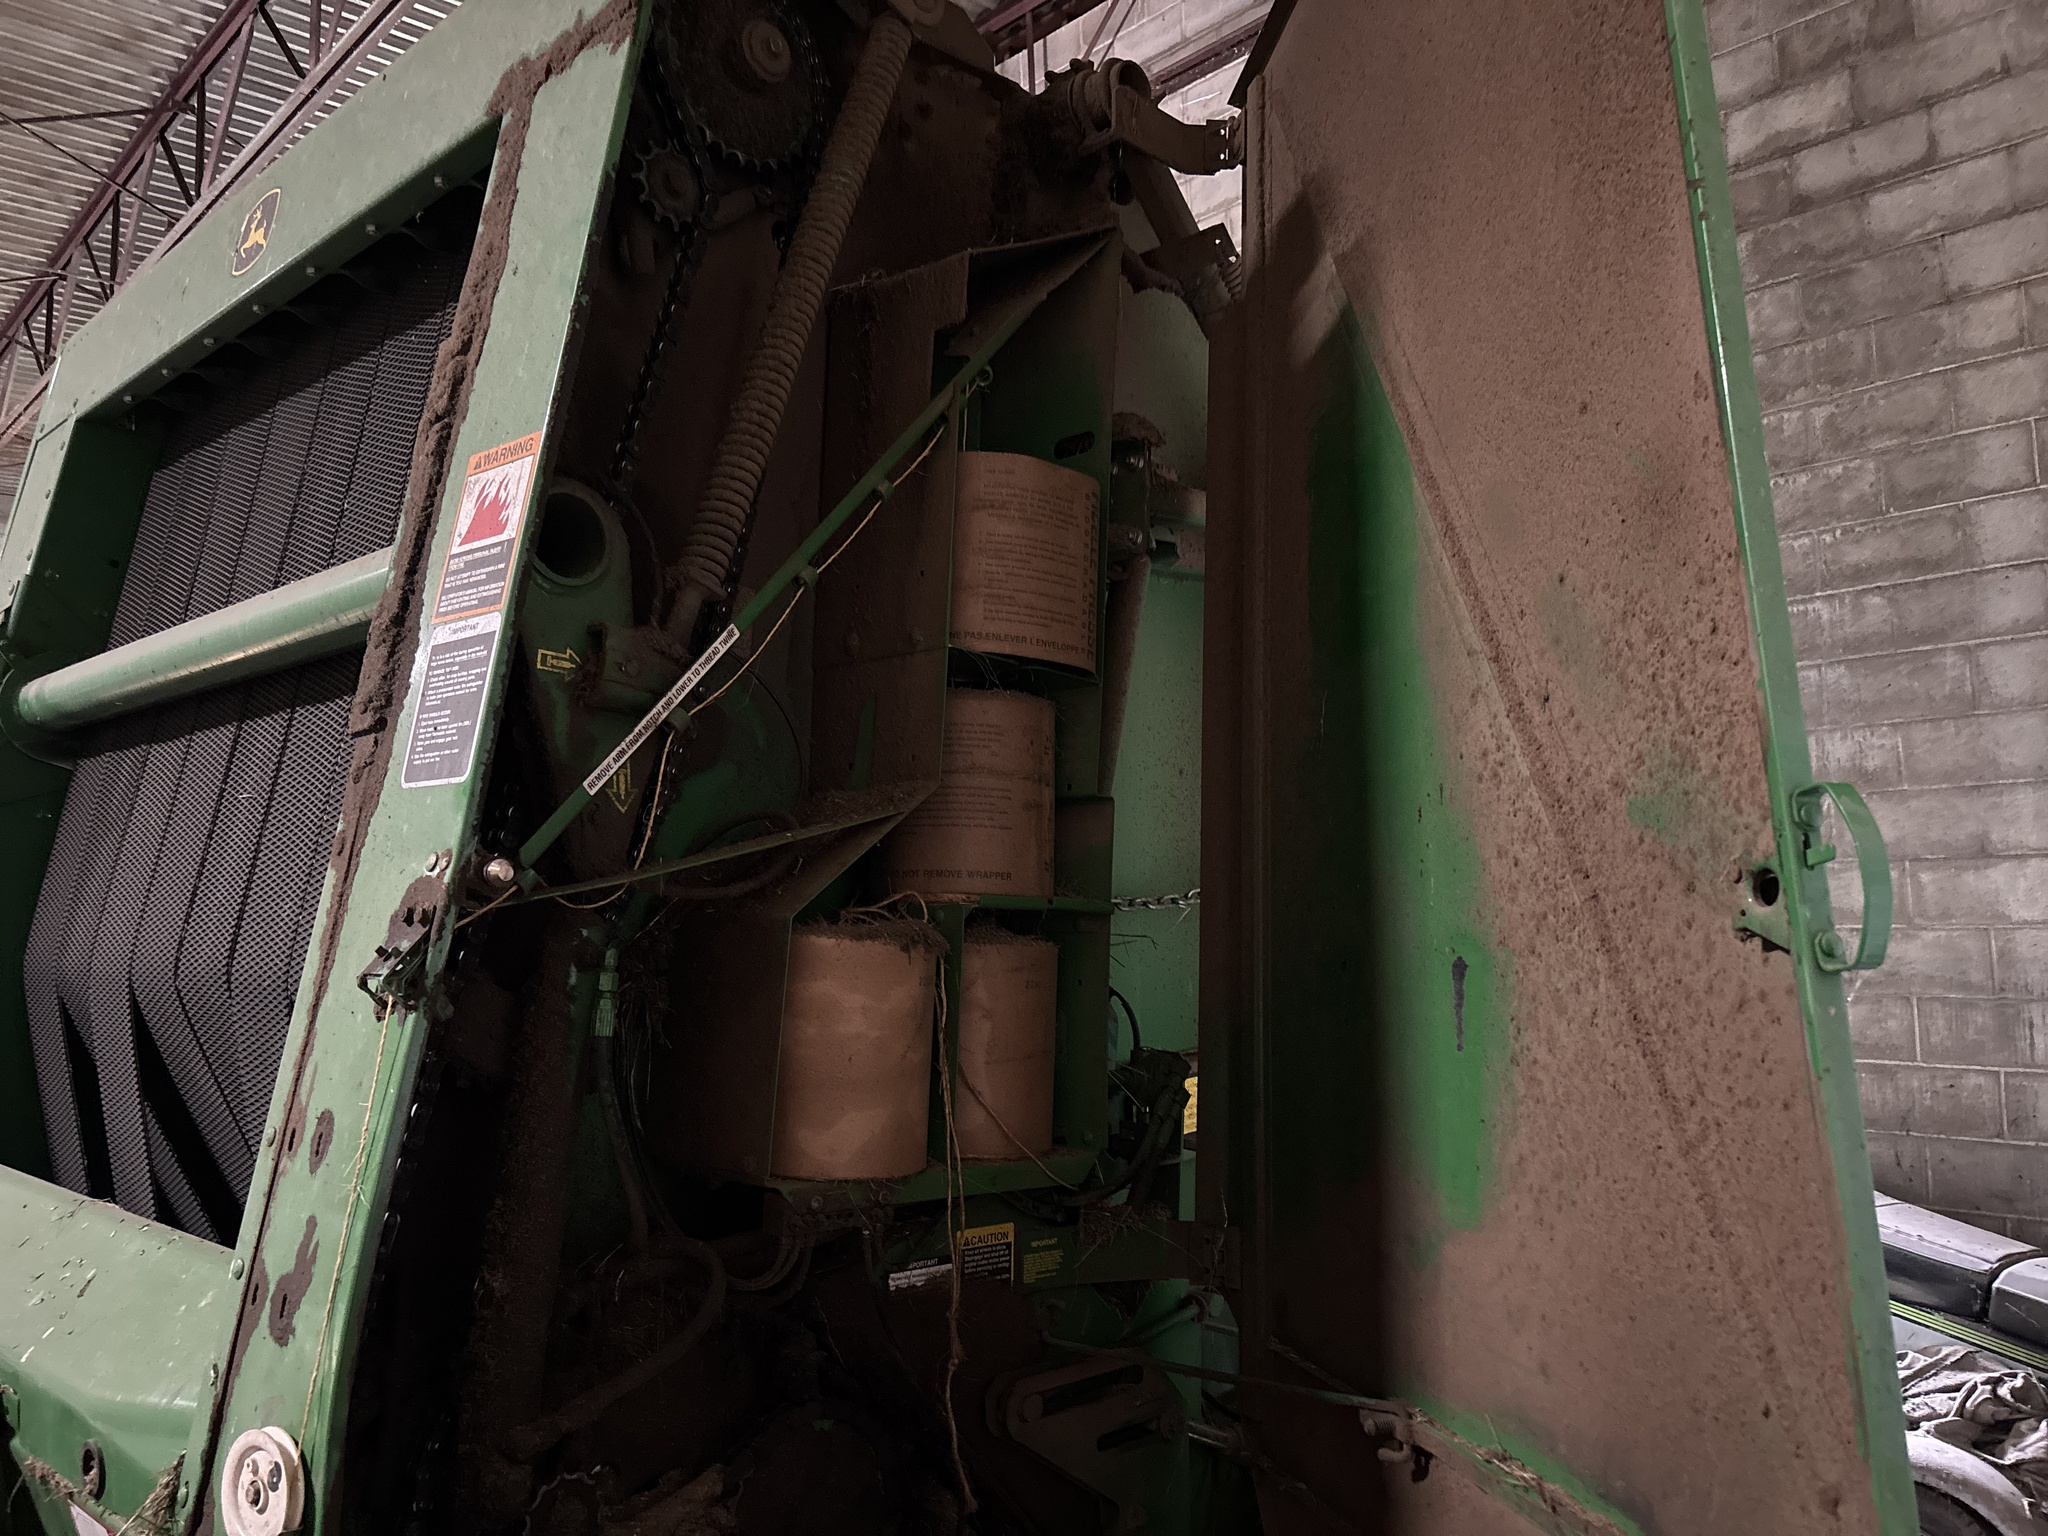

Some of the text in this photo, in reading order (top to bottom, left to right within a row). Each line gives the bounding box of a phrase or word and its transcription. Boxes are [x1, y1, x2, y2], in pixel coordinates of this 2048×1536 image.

[483, 437, 534, 466] WARNING
[964, 631, 983, 641] PAS
[985, 632, 1028, 645] ENLEVER
[1030, 637, 1080, 654] L'ENVELOPPE
[587, 627, 738, 791] REMOVE ARM FROM NOTCH AND LOWER TO THREAD TWINE
[902, 870, 919, 879] NOT
[923, 869, 962, 879] REMOVE
[967, 870, 1012, 881] WRAPPER
[970, 1231, 1009, 1245] CAUTION
